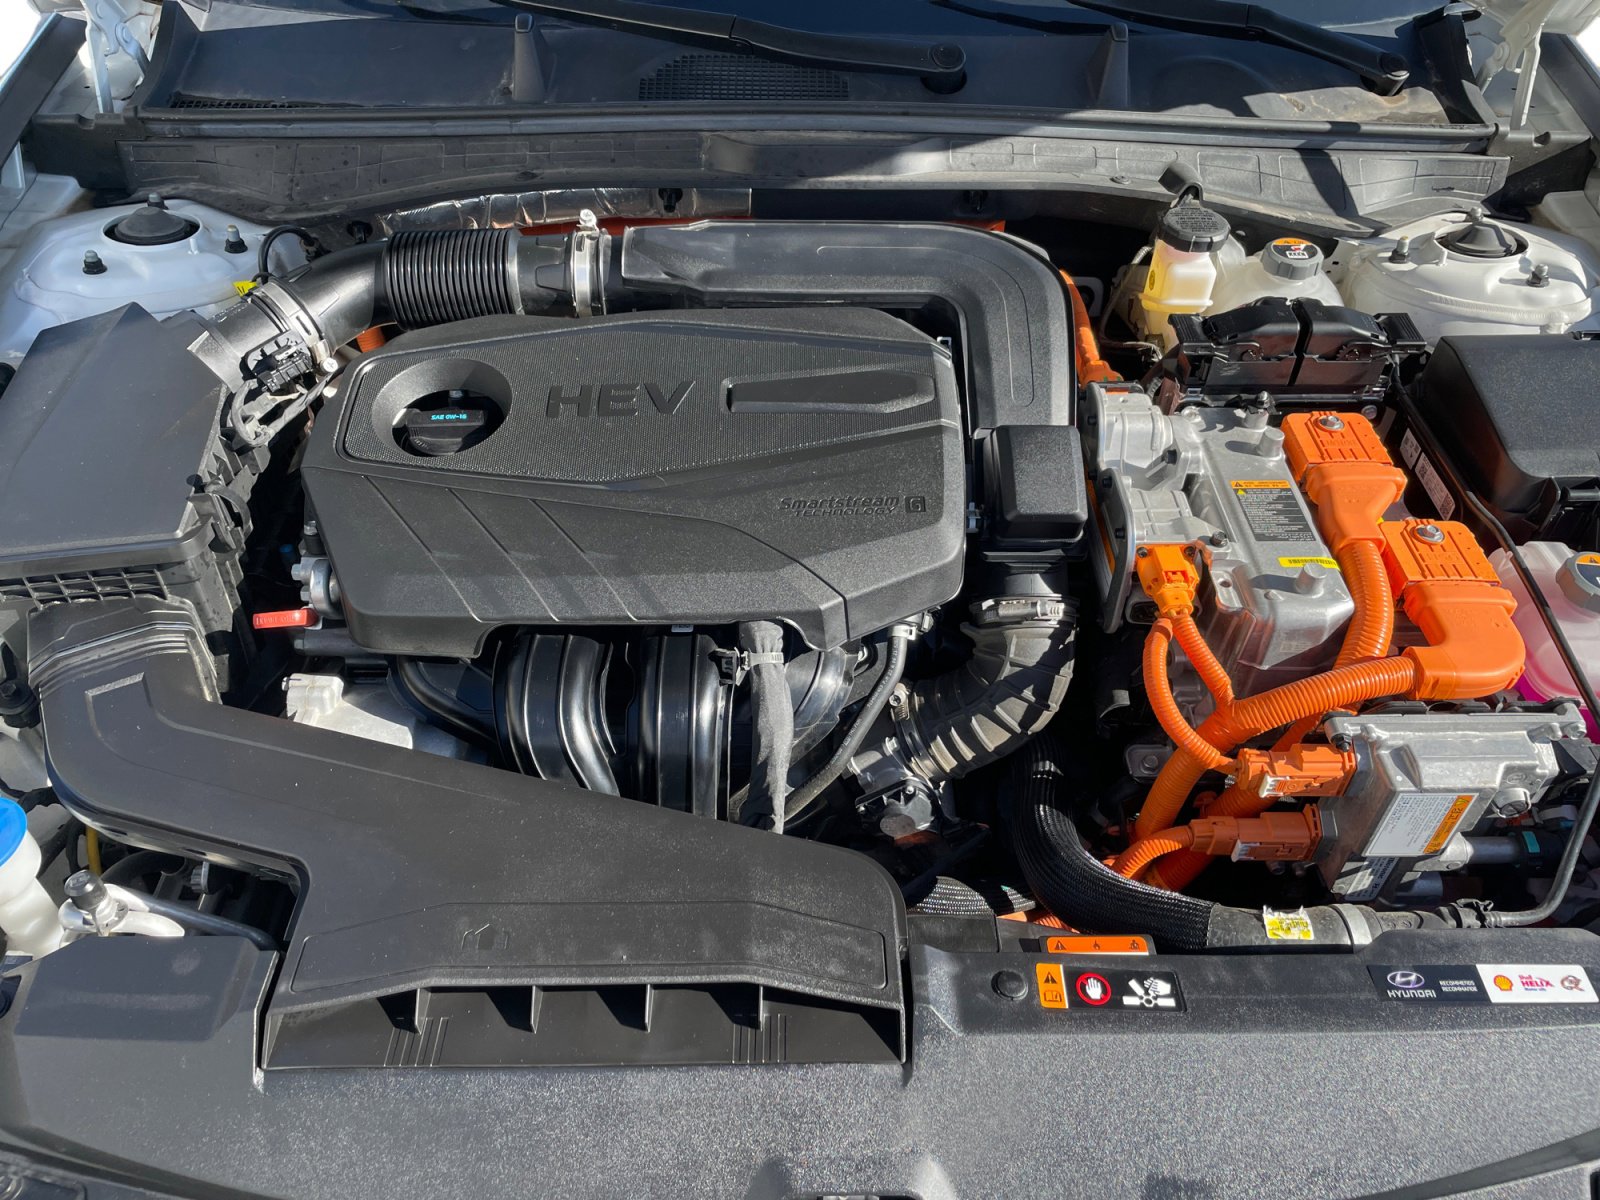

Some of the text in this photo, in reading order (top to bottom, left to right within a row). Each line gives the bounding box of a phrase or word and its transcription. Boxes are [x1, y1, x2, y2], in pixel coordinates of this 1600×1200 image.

[545, 380, 696, 419] HEV
[778, 496, 900, 510] Smartstream
[794, 507, 896, 517] TECHNOLOGY
[1521, 979, 1555, 987] HELIX
[1387, 989, 1437, 998] HYUNDAI
